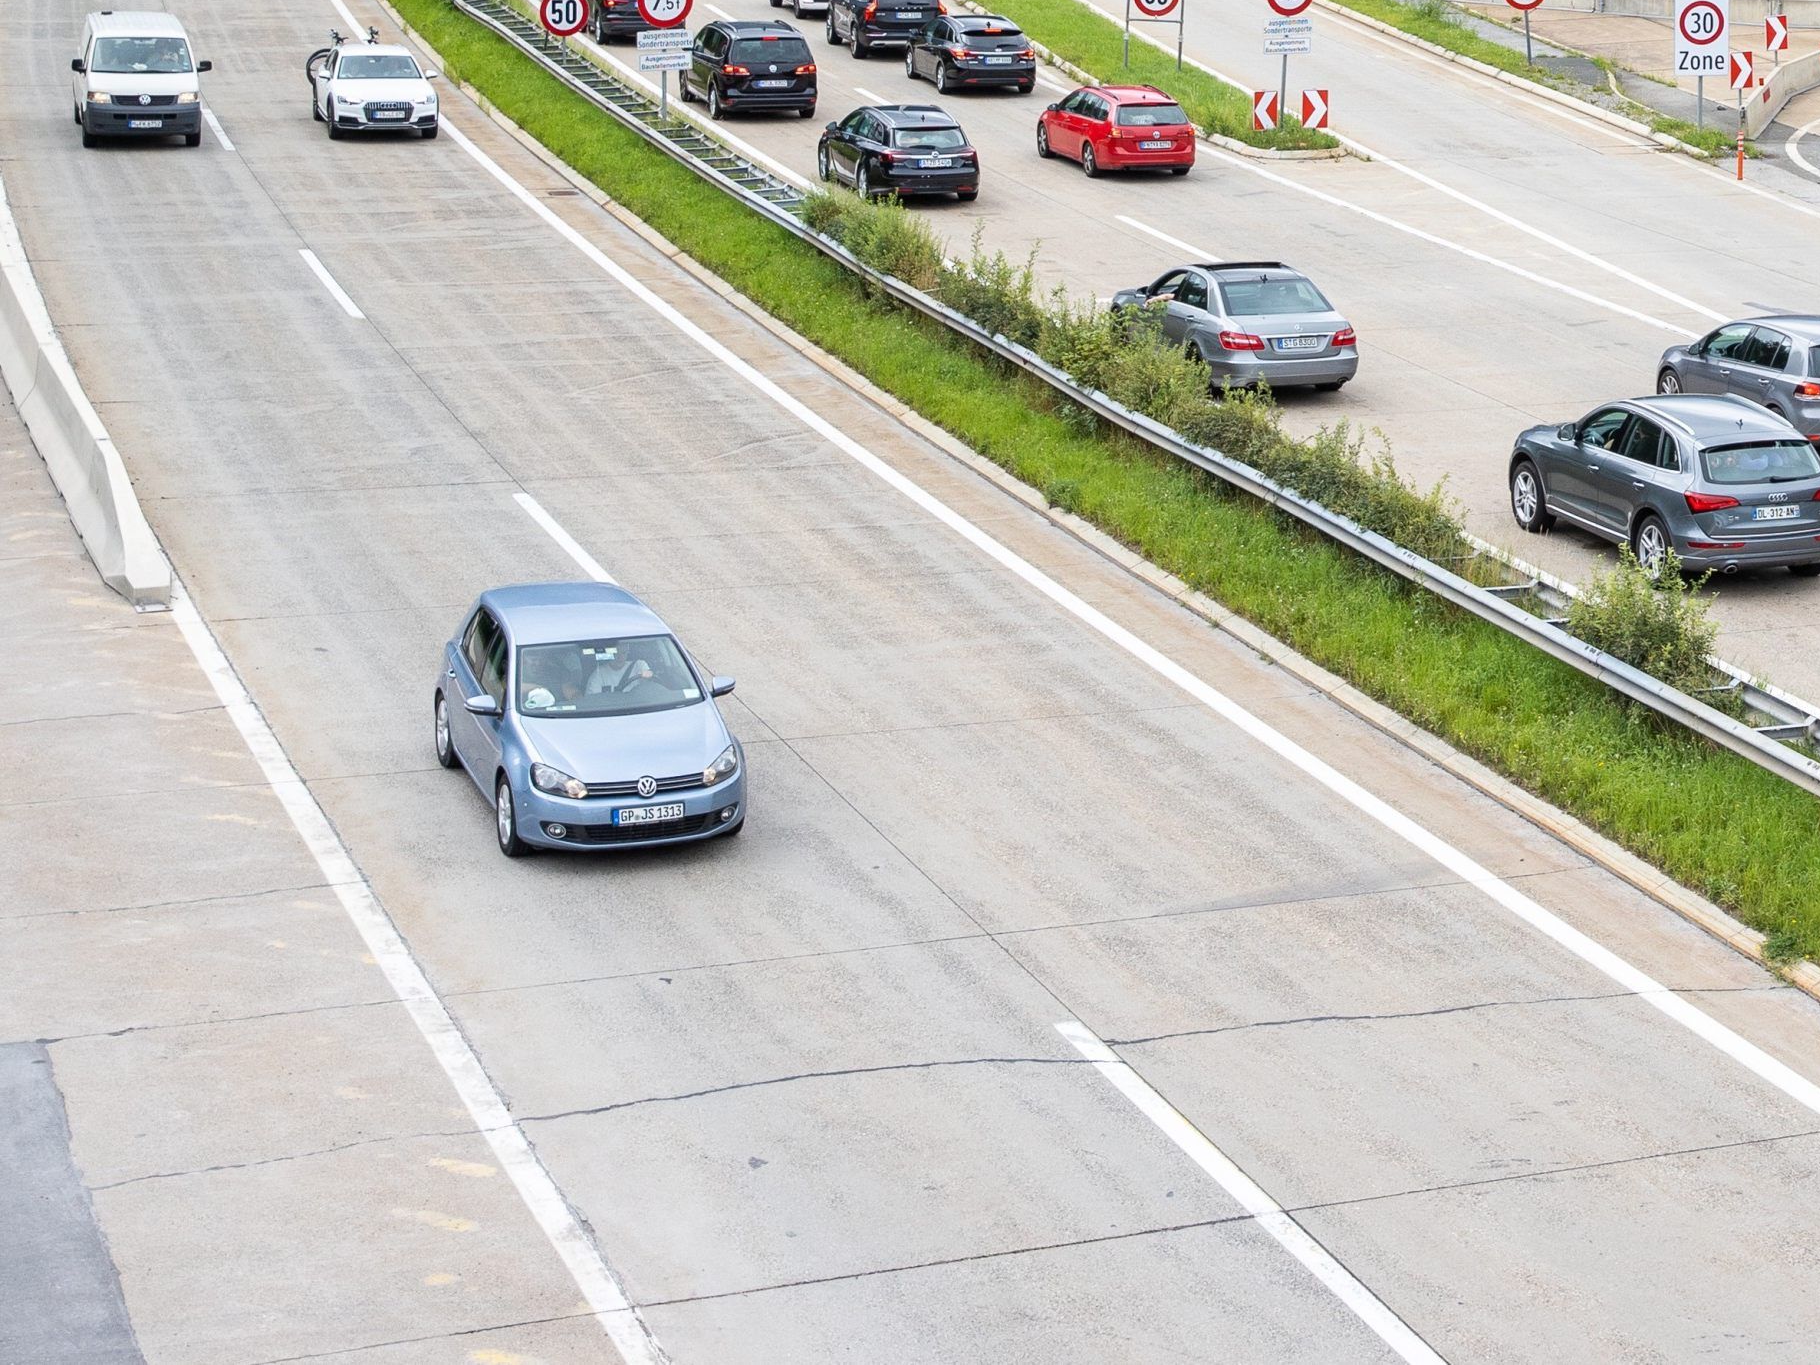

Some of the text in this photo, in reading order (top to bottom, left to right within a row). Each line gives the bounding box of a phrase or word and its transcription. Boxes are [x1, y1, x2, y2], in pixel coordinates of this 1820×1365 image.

[551, 0, 578, 25] 50
[1690, 12, 1714, 34] 30
[1678, 50, 1725, 71] Zone
[620, 804, 683, 822] GP JS 1313
